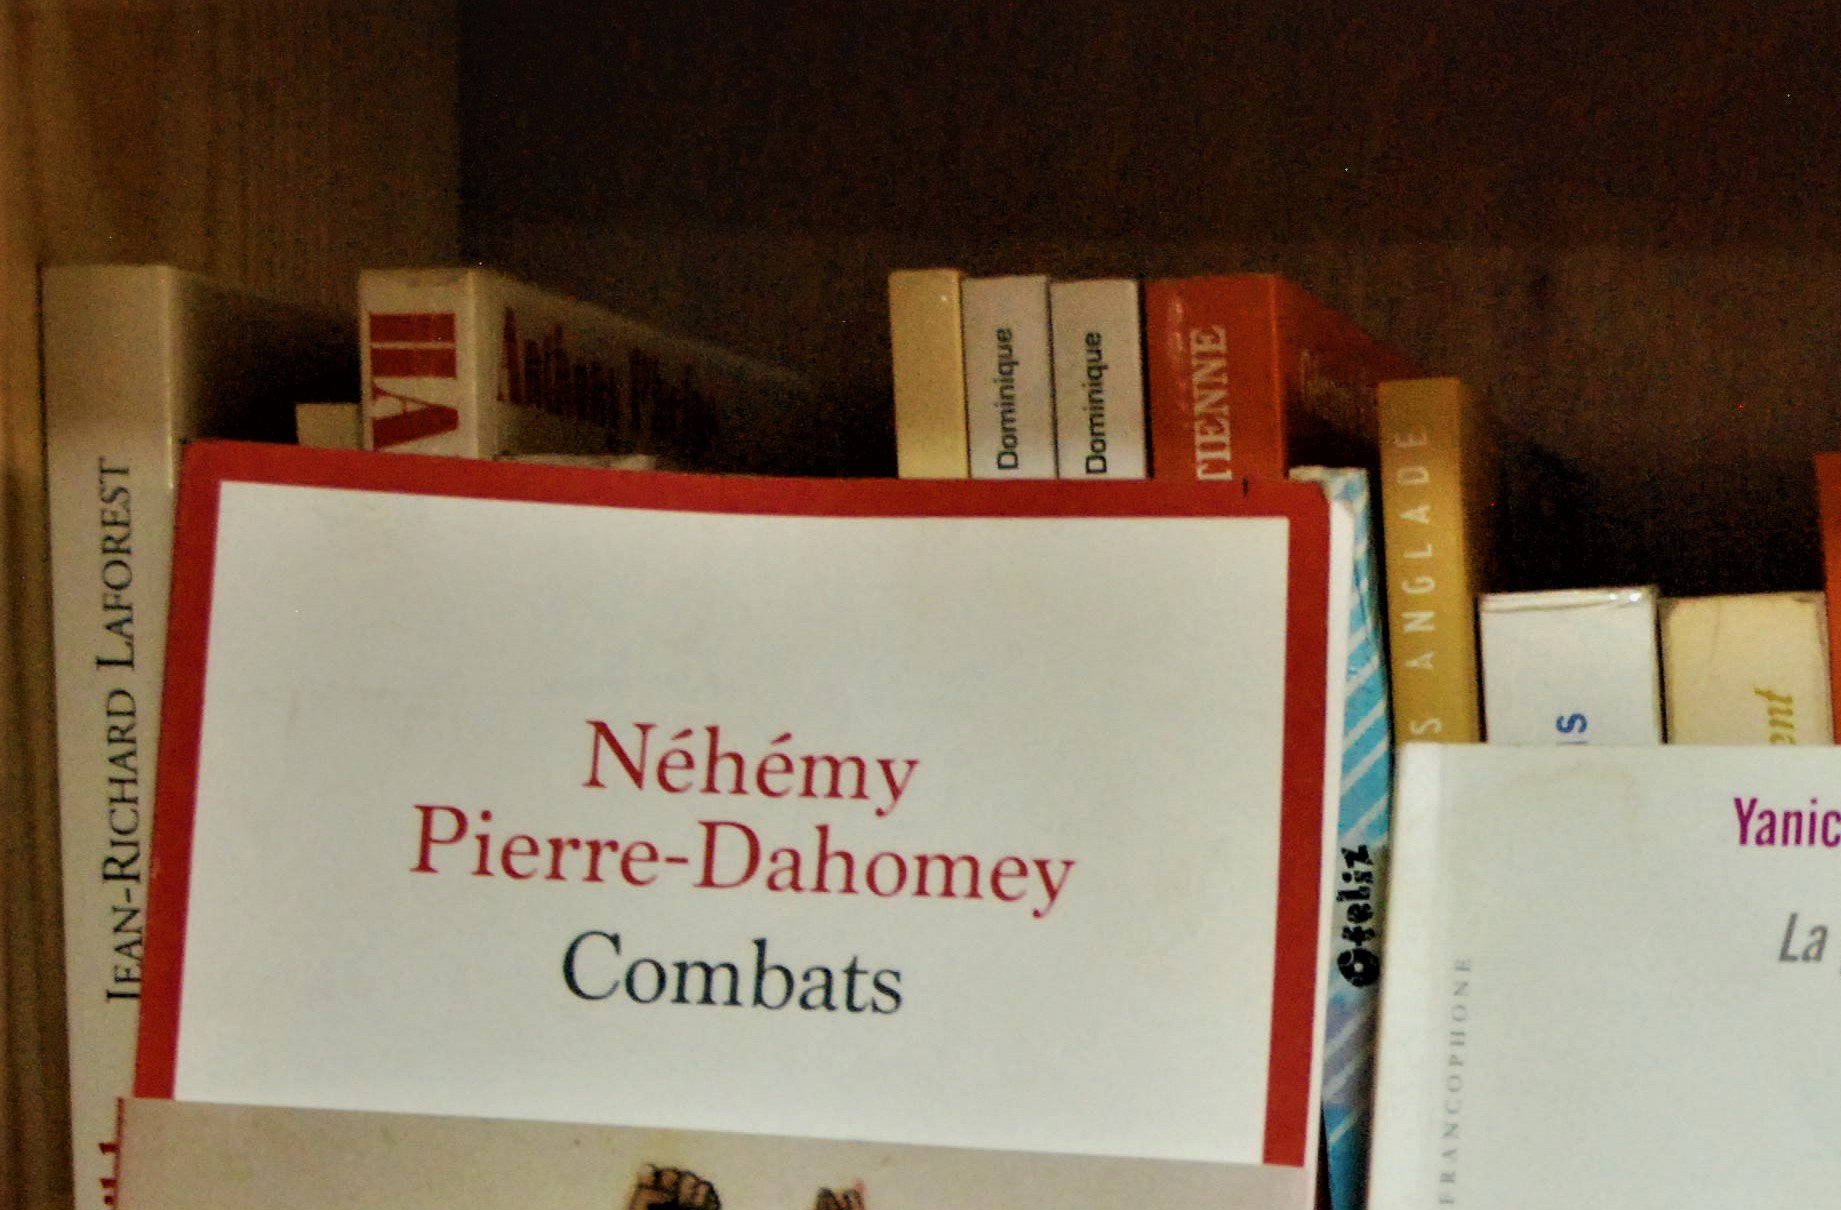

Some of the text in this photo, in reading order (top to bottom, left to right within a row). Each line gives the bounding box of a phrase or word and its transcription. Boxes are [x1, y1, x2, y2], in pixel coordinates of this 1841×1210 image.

[996, 325, 1018, 472] Dominique
[1084, 330, 1110, 476] Dominique
[1399, 428, 1436, 671] ANGLADE
[95, 455, 146, 1004] JEAN-RICHARD LAFOREST
[582, 717, 919, 818] Néhémy
[408, 803, 1077, 920] Pierre-Dahomey
[560, 929, 904, 1016] Combats
[1777, 911, 1830, 965] La
[1437, 956, 1473, 1207] FRANCOPHONE
